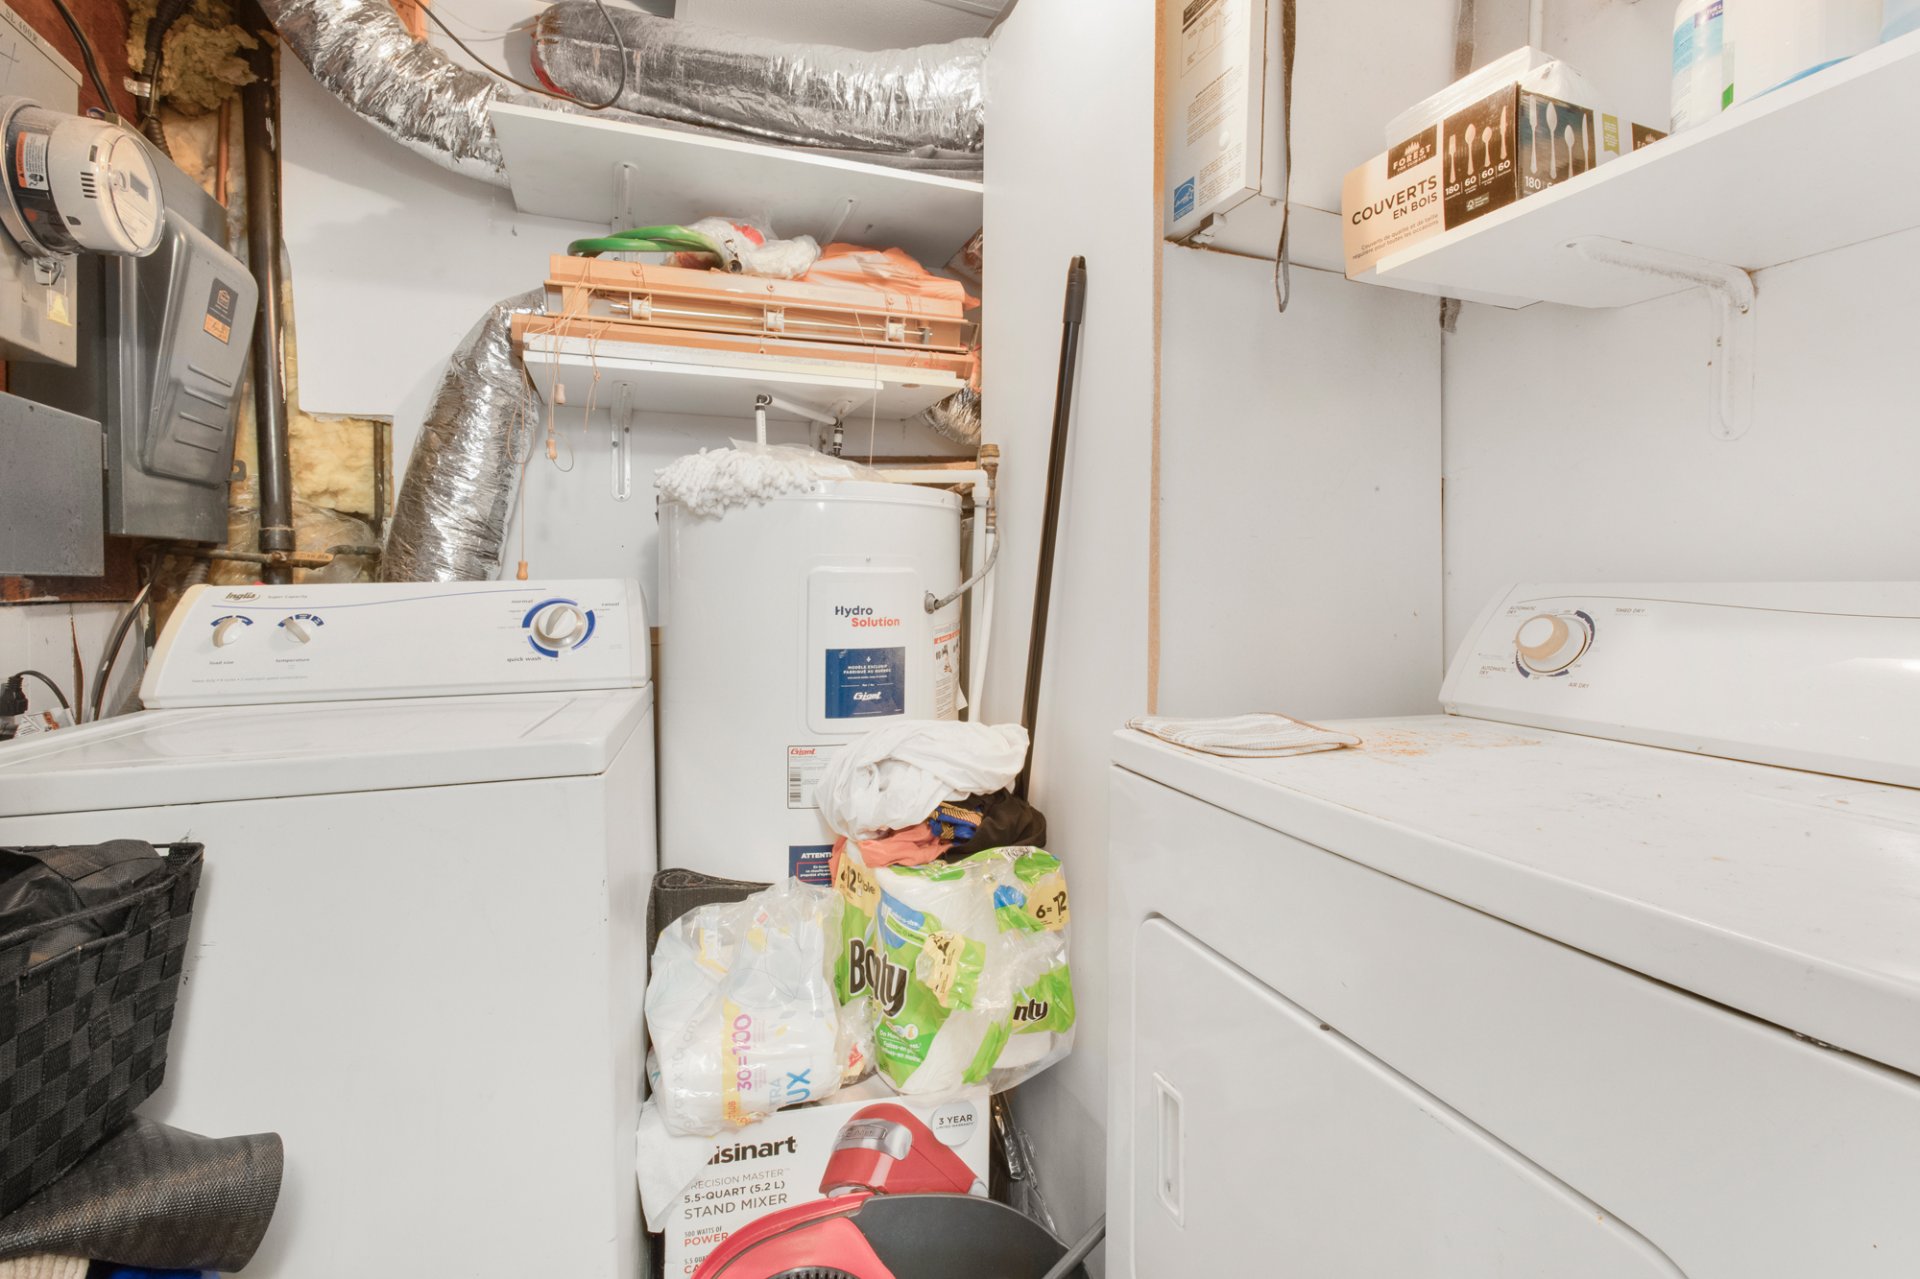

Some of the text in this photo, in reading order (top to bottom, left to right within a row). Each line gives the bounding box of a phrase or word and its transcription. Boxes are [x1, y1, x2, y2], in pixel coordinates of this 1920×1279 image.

[1392, 144, 1432, 170] FOREST
[1445, 184, 1460, 196] 180
[1464, 176, 1476, 186] 60
[1482, 168, 1494, 178] 60
[1498, 160, 1510, 171] 60
[1524, 176, 1541, 190] 180
[1352, 175, 1438, 226] COUVERTS
[1393, 206, 1408, 220] EN
[1411, 192, 1438, 212] BOIS
[225, 592, 257, 601] Inglis
[834, 605, 873, 618] Hydro
[851, 616, 900, 627] Solution
[853, 691, 882, 702] Giant
[939, 1114, 973, 1126] 3 YEAR
[707, 1136, 796, 1165] isinart
[691, 1168, 784, 1190] RECISION MASTER
[684, 1180, 785, 1204] 5.5-QUART (5.2 L)
[684, 1193, 788, 1220] STAND MIXER
[684, 1232, 728, 1247] POWER
[697, 1227, 715, 1236] WATTS
